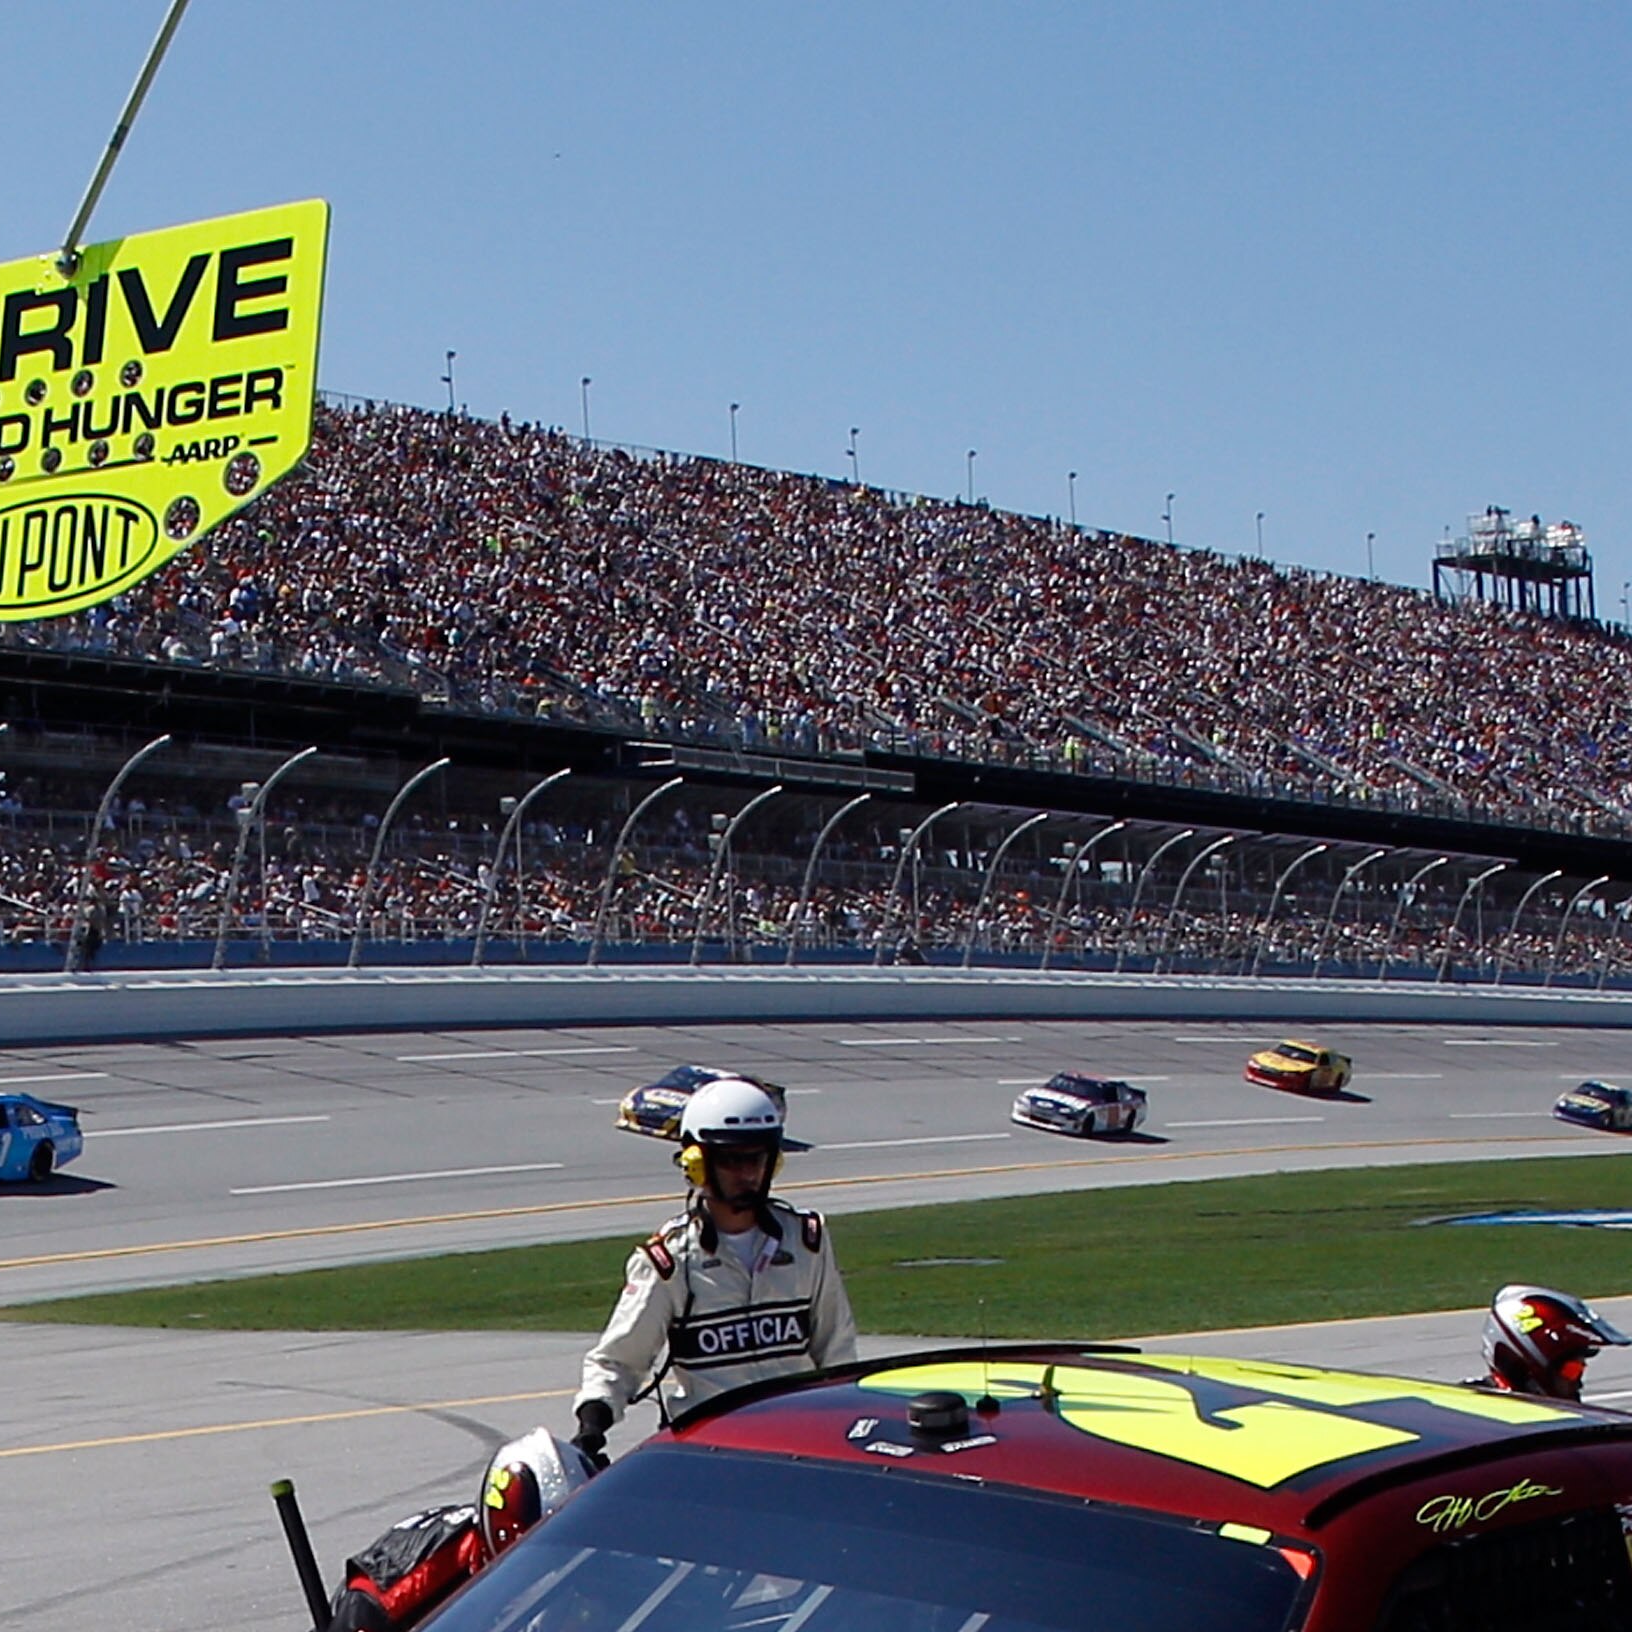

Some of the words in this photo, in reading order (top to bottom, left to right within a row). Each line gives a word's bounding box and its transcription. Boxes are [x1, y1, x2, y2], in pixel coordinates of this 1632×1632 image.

[41, 366, 284, 449] HUNGER
[166, 436, 240, 465] AARP
[698, 1316, 803, 1353] OFFICIA
[858, 1353, 1581, 1489] 24
